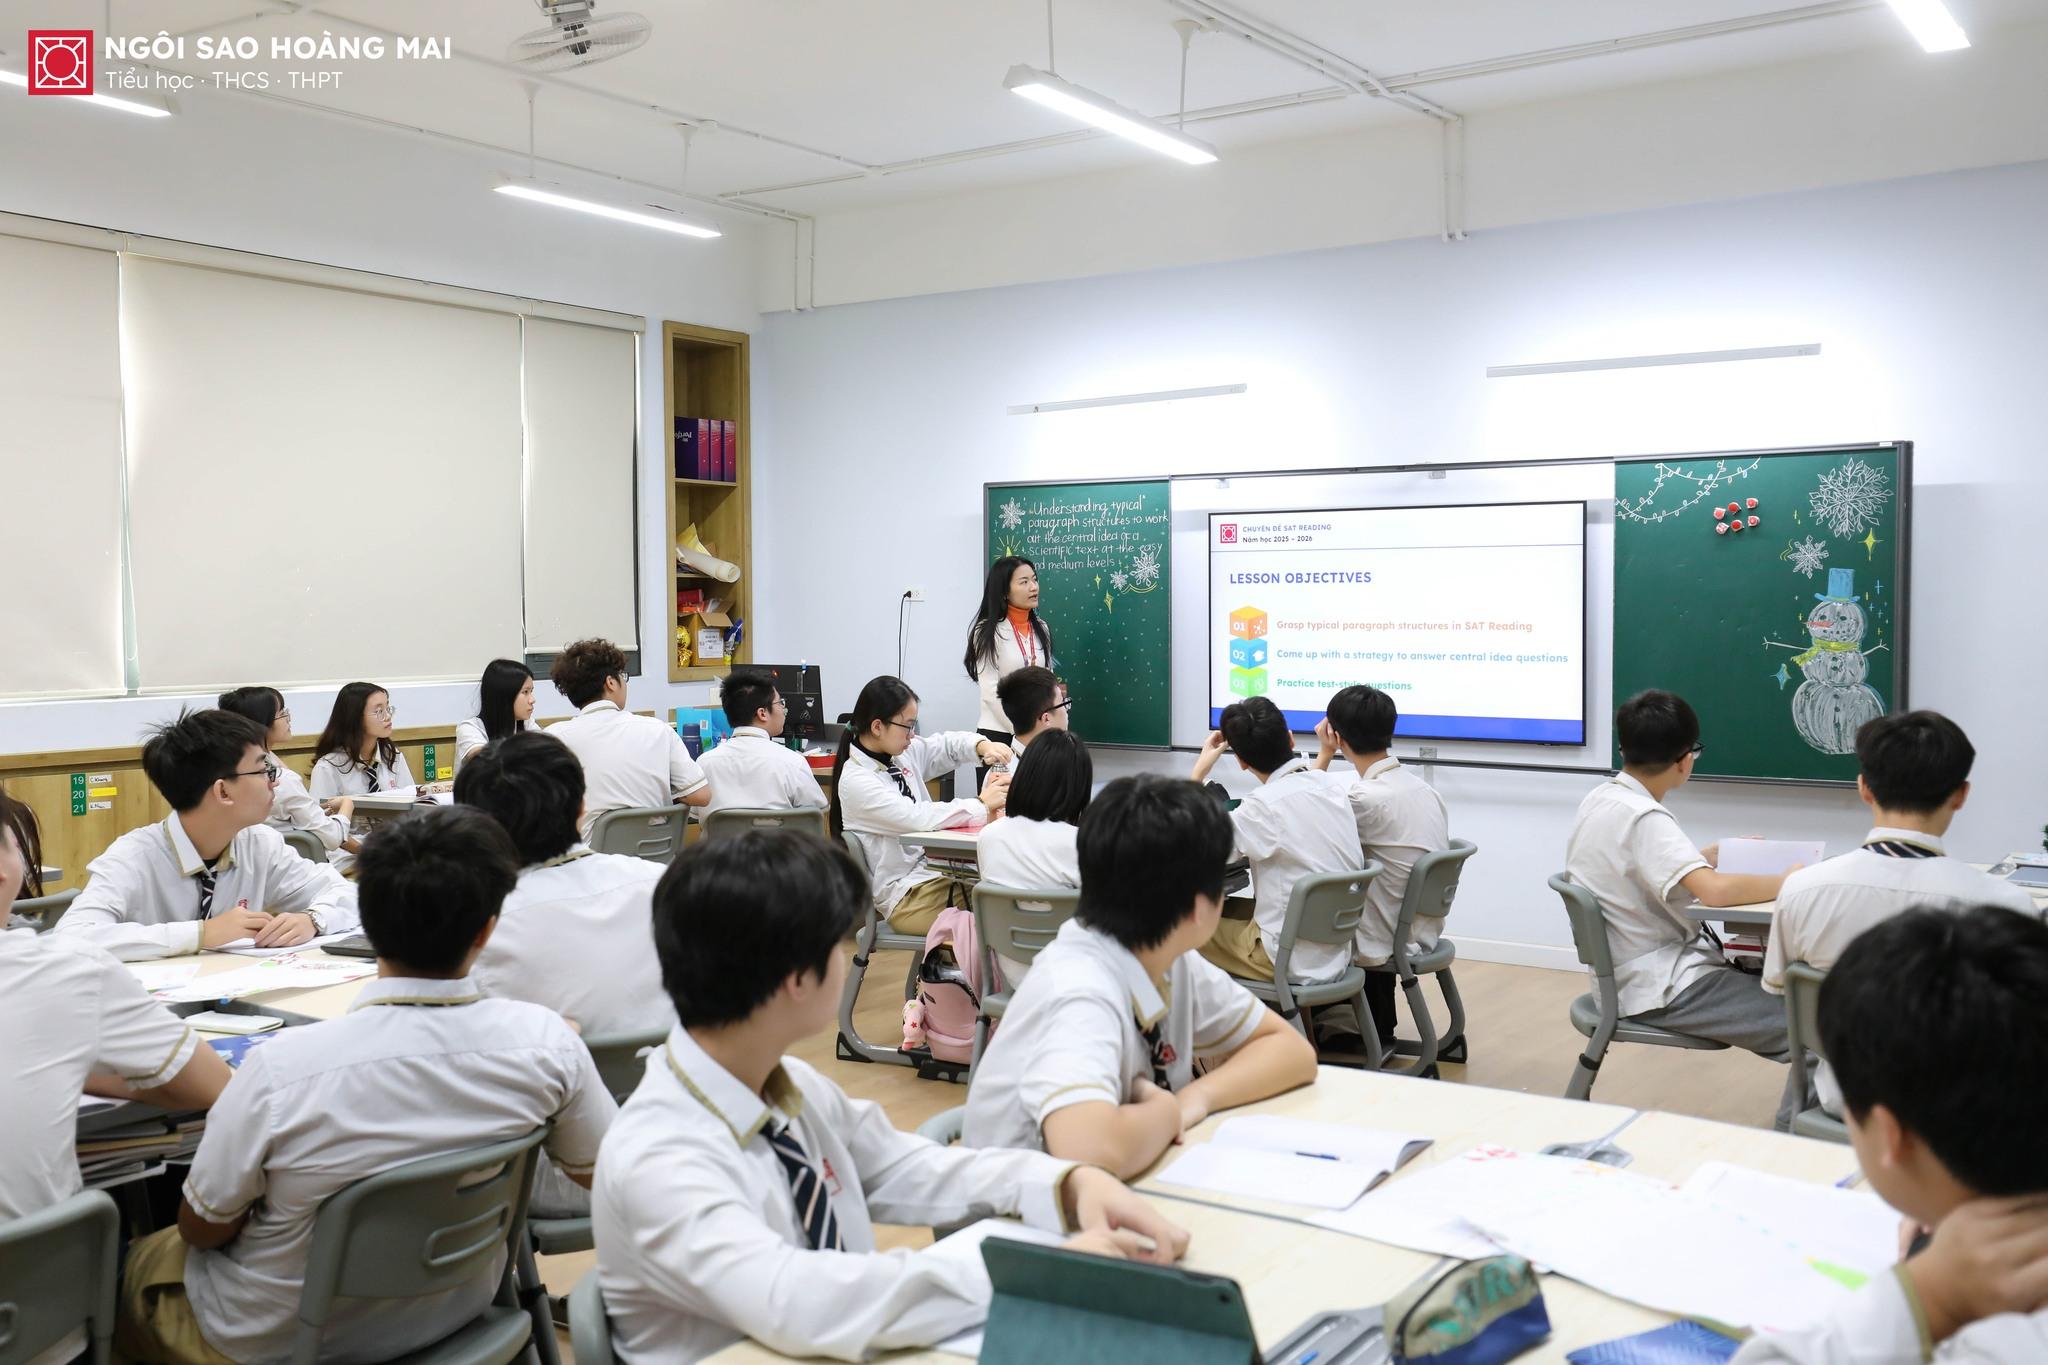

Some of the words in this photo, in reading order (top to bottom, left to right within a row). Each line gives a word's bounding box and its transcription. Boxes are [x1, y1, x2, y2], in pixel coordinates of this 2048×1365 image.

[1033, 497, 1108, 519] Understanding
[1111, 495, 1142, 520] typical
[1028, 514, 1080, 536] paragraph
[1082, 517, 1130, 528] structures
[1133, 515, 1142, 524] to
[1145, 510, 1168, 524] work
[1299, 524, 1332, 532] READING
[1044, 531, 1060, 543] the
[1061, 527, 1096, 543] central
[1098, 528, 1118, 542] idea
[1075, 545, 1099, 554] text
[1101, 544, 1113, 554] at
[1116, 541, 1135, 553] the
[1138, 542, 1163, 560] easy
[1048, 556, 1084, 570] medium
[1087, 553, 1115, 568] levels
[1230, 573, 1280, 584] LESSON
[1285, 572, 1372, 584] OBJECTIVES
[1233, 621, 1246, 632] 01
[1276, 621, 1305, 632] Grasp
[1307, 620, 1340, 633] typical
[1342, 620, 1395, 633] paragraph
[1398, 621, 1449, 631] structures
[1452, 620, 1462, 631] in
[1465, 622, 1485, 631] SAT
[1489, 621, 1533, 633] Reading
[1232, 649, 1246, 661] 02
[1276, 649, 1303, 659] Come
[1306, 652, 1318, 661] up
[1320, 649, 1341, 660] with
[1344, 652, 1350, 660] a
[1353, 650, 1394, 663] strategy
[1397, 651, 1407, 661] to
[1410, 652, 1446, 661] answer
[1450, 652, 1487, 662] central
[1490, 651, 1513, 662] idea
[1516, 653, 1569, 664] questions
[1276, 678, 1315, 688] Practice
[425, 747, 434, 755] 28
[425, 759, 434, 767] 29
[73, 776, 84, 785] 19
[425, 771, 434, 779] 30
[73, 790, 84, 799] 20
[73, 804, 84, 813] 21
